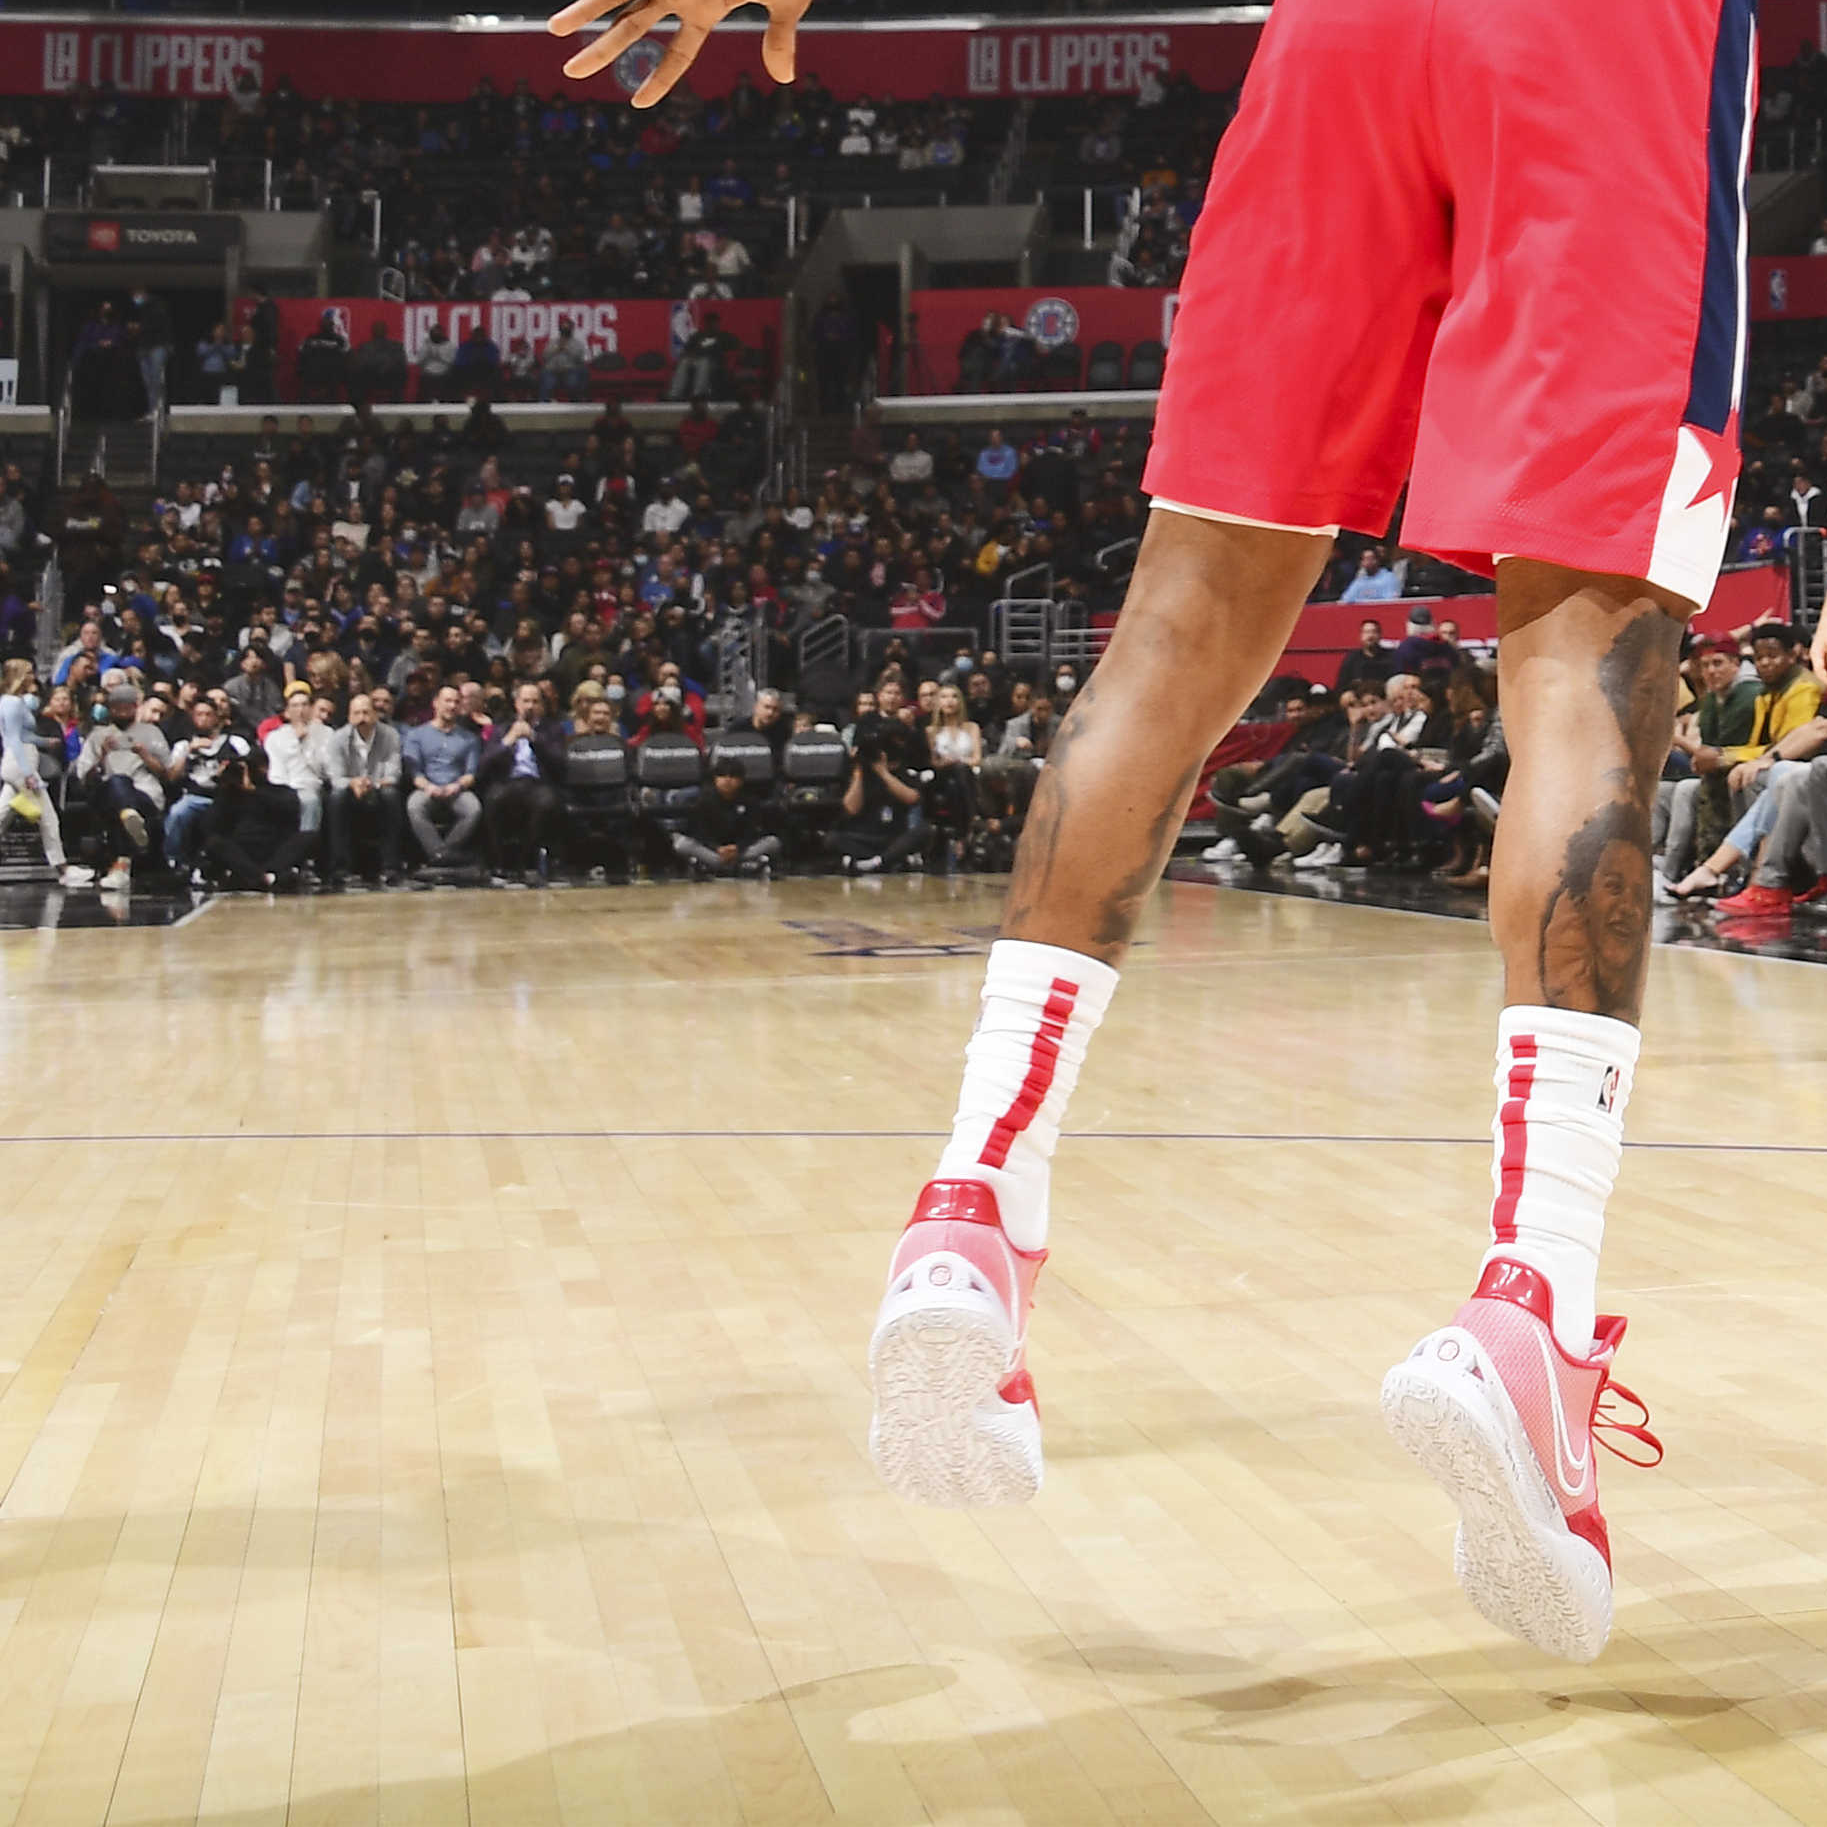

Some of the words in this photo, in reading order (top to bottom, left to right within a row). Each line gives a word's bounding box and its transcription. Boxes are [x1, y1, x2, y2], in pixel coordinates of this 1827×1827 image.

[44, 32, 80, 92] LA
[89, 33, 265, 94] CLIPPERS
[969, 36, 1000, 93] LA
[1010, 32, 1172, 92] CLIPPERS
[125, 228, 198, 244] TOYOTA
